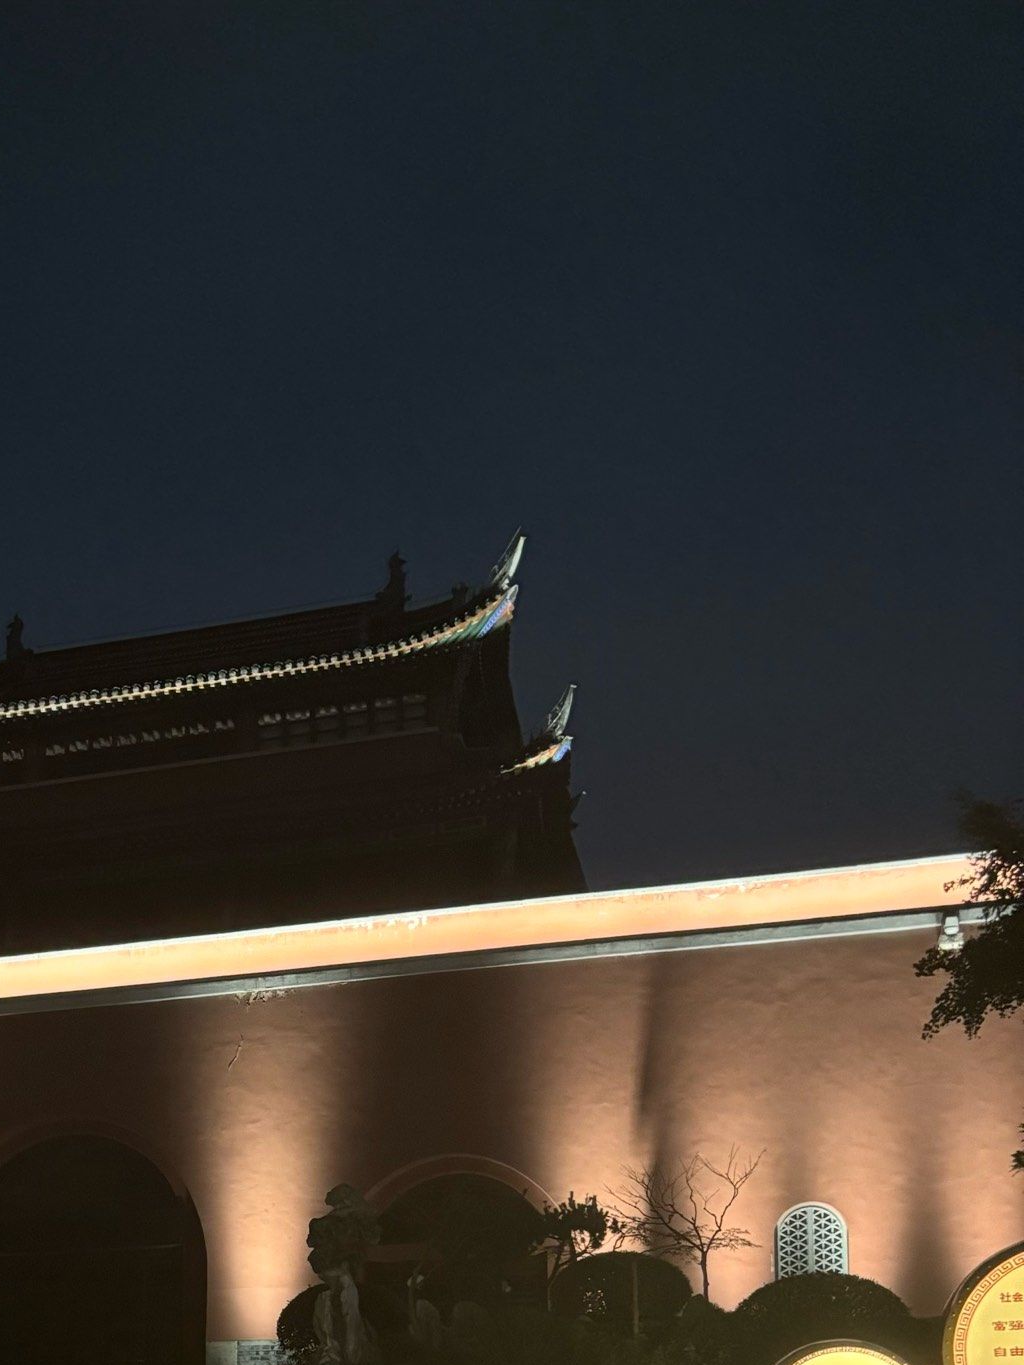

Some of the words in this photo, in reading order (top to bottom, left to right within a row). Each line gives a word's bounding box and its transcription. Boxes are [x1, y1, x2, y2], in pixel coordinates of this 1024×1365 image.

[1000, 1292, 1024, 1303] 社会
[992, 1320, 1024, 1331] 富强
[994, 1346, 1024, 1357] 自由
